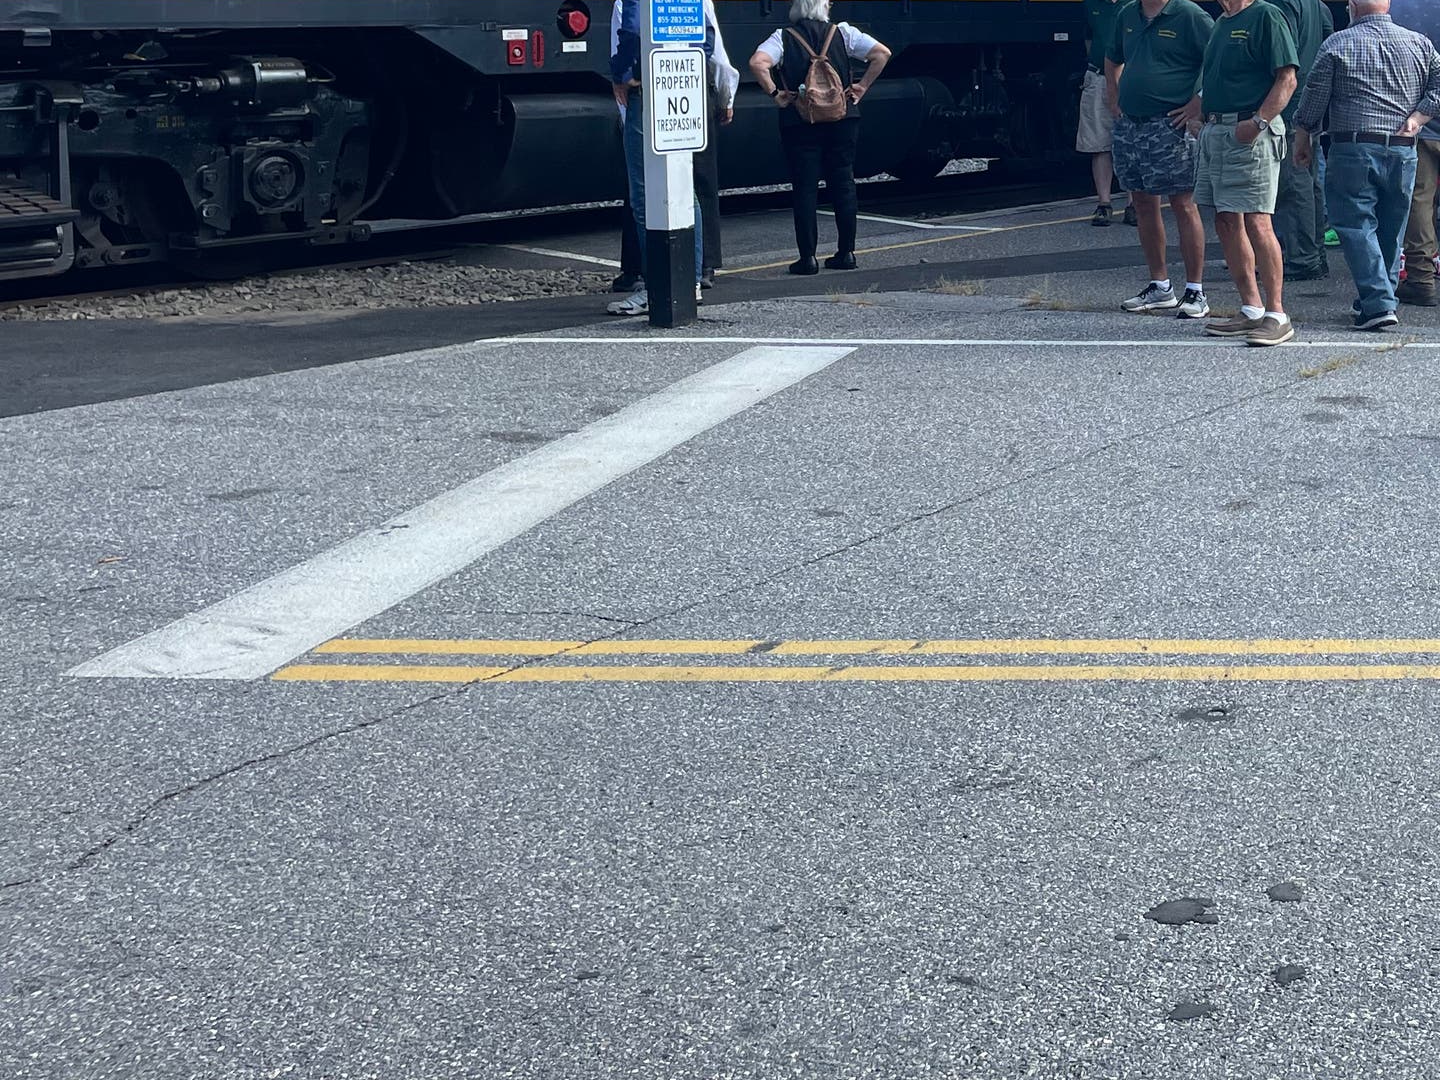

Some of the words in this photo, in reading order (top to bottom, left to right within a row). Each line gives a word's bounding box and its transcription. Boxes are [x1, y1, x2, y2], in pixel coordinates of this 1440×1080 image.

[667, 6, 699, 14] EMERGENCY
[659, 58, 696, 73] PRIVATE
[656, 75, 700, 90] PROPERTY
[668, 96, 690, 115] NO
[657, 117, 702, 132] TRESPASSING
